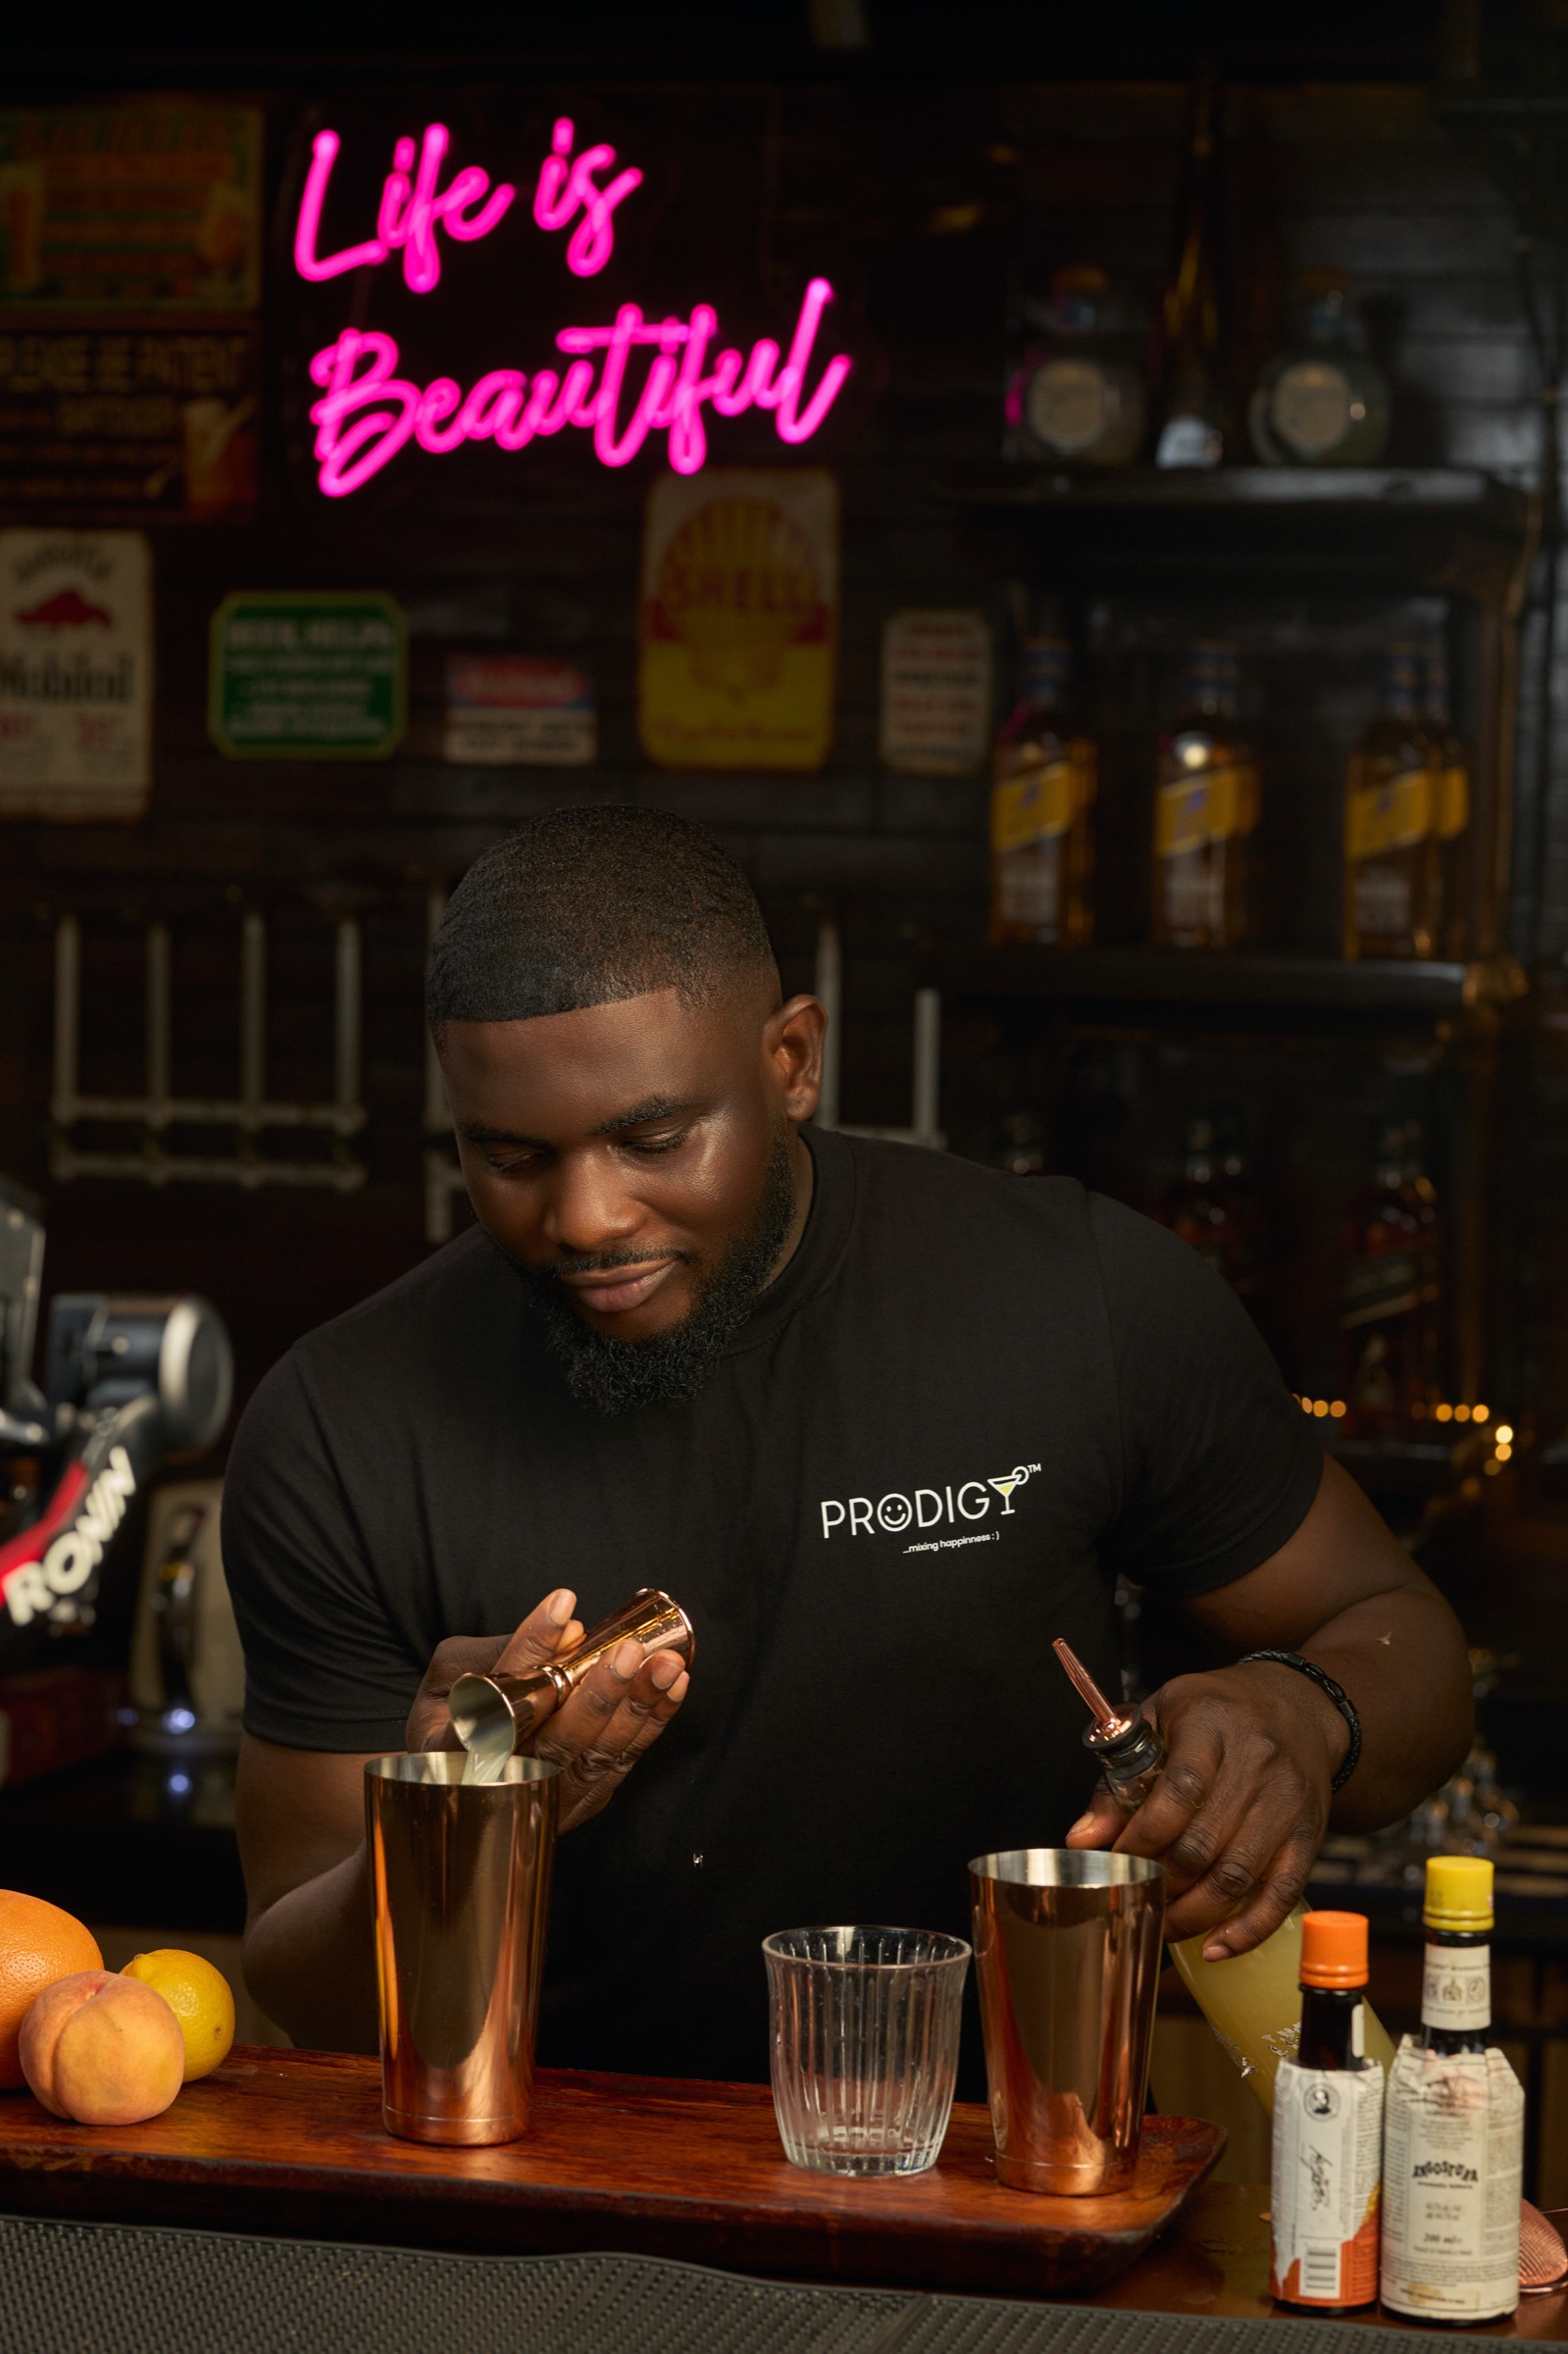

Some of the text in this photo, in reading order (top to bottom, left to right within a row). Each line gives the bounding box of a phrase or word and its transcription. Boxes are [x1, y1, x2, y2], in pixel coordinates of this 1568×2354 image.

[294, 117, 643, 294] Life is
[309, 278, 851, 497] Beautiful
